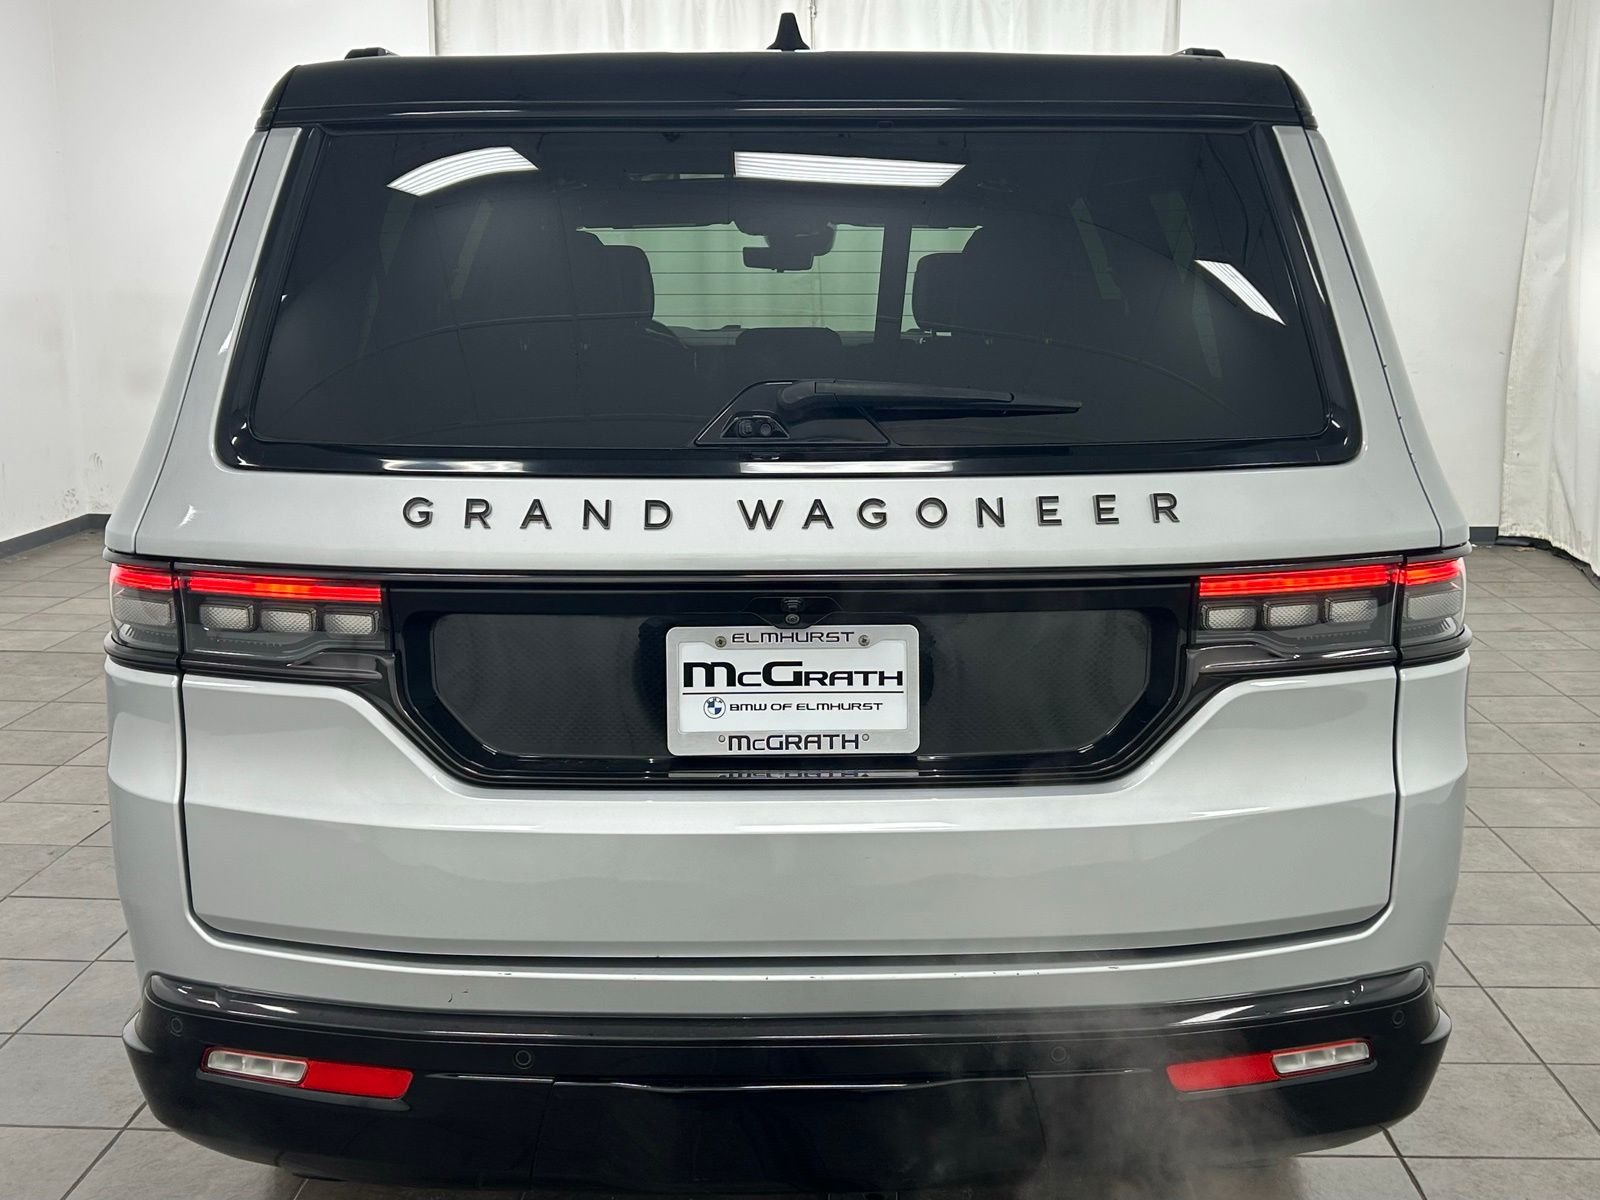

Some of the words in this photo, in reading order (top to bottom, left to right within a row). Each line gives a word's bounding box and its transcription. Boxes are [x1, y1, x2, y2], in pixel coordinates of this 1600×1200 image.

[402, 496, 673, 531] GRAND
[736, 492, 1181, 531] WAGONEER
[731, 631, 855, 643] ELMHURST
[729, 703, 768, 711] BMW
[770, 703, 793, 711] OF
[796, 702, 883, 711] ELMHURST
